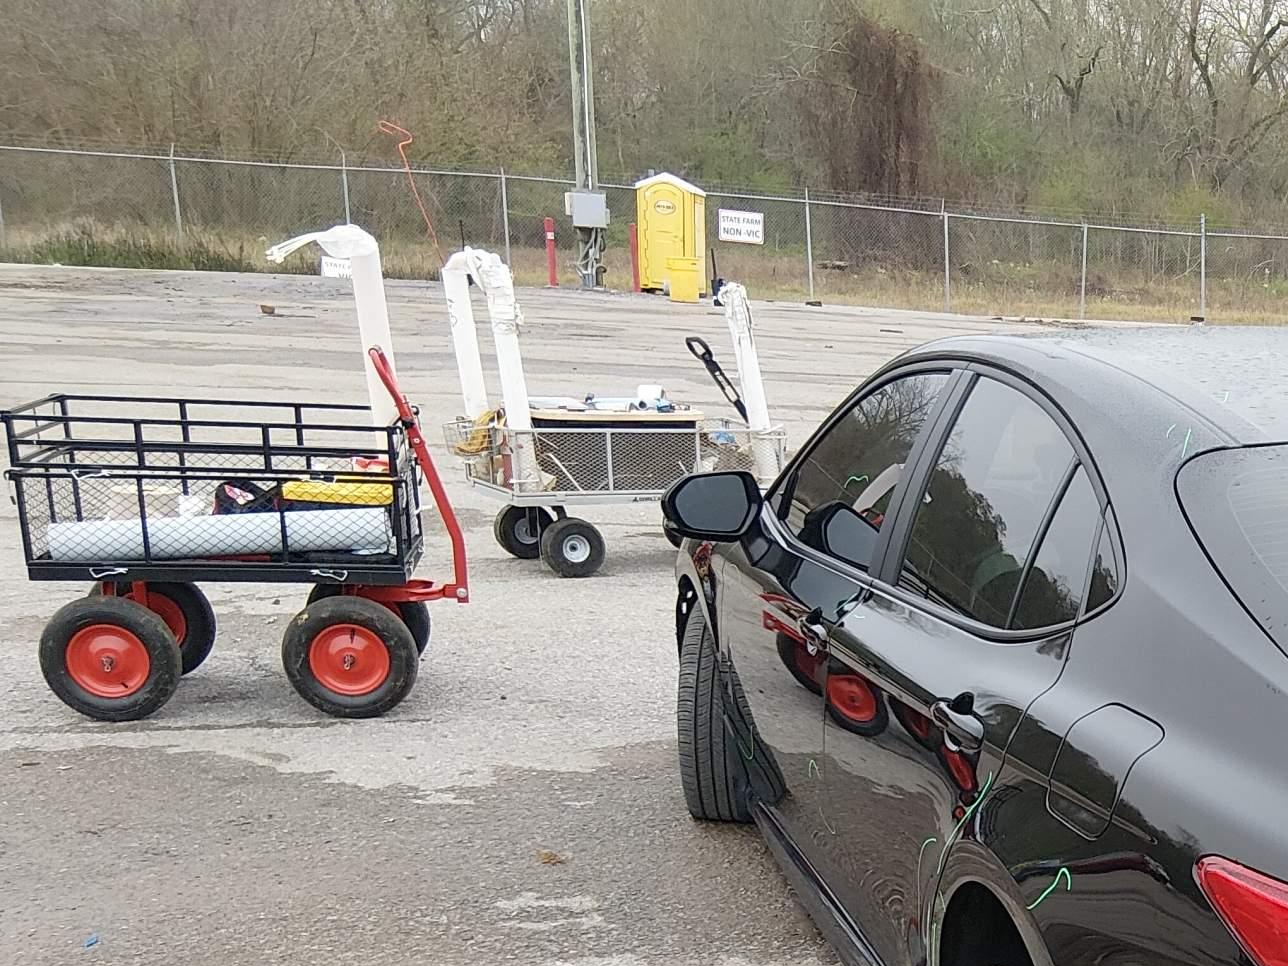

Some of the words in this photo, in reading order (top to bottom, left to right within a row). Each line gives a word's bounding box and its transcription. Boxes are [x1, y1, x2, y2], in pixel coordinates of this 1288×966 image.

[722, 215, 741, 224] STATE
[742, 217, 761, 226] FARM
[723, 226, 742, 236] NON
[324, 261, 347, 270] STATE
